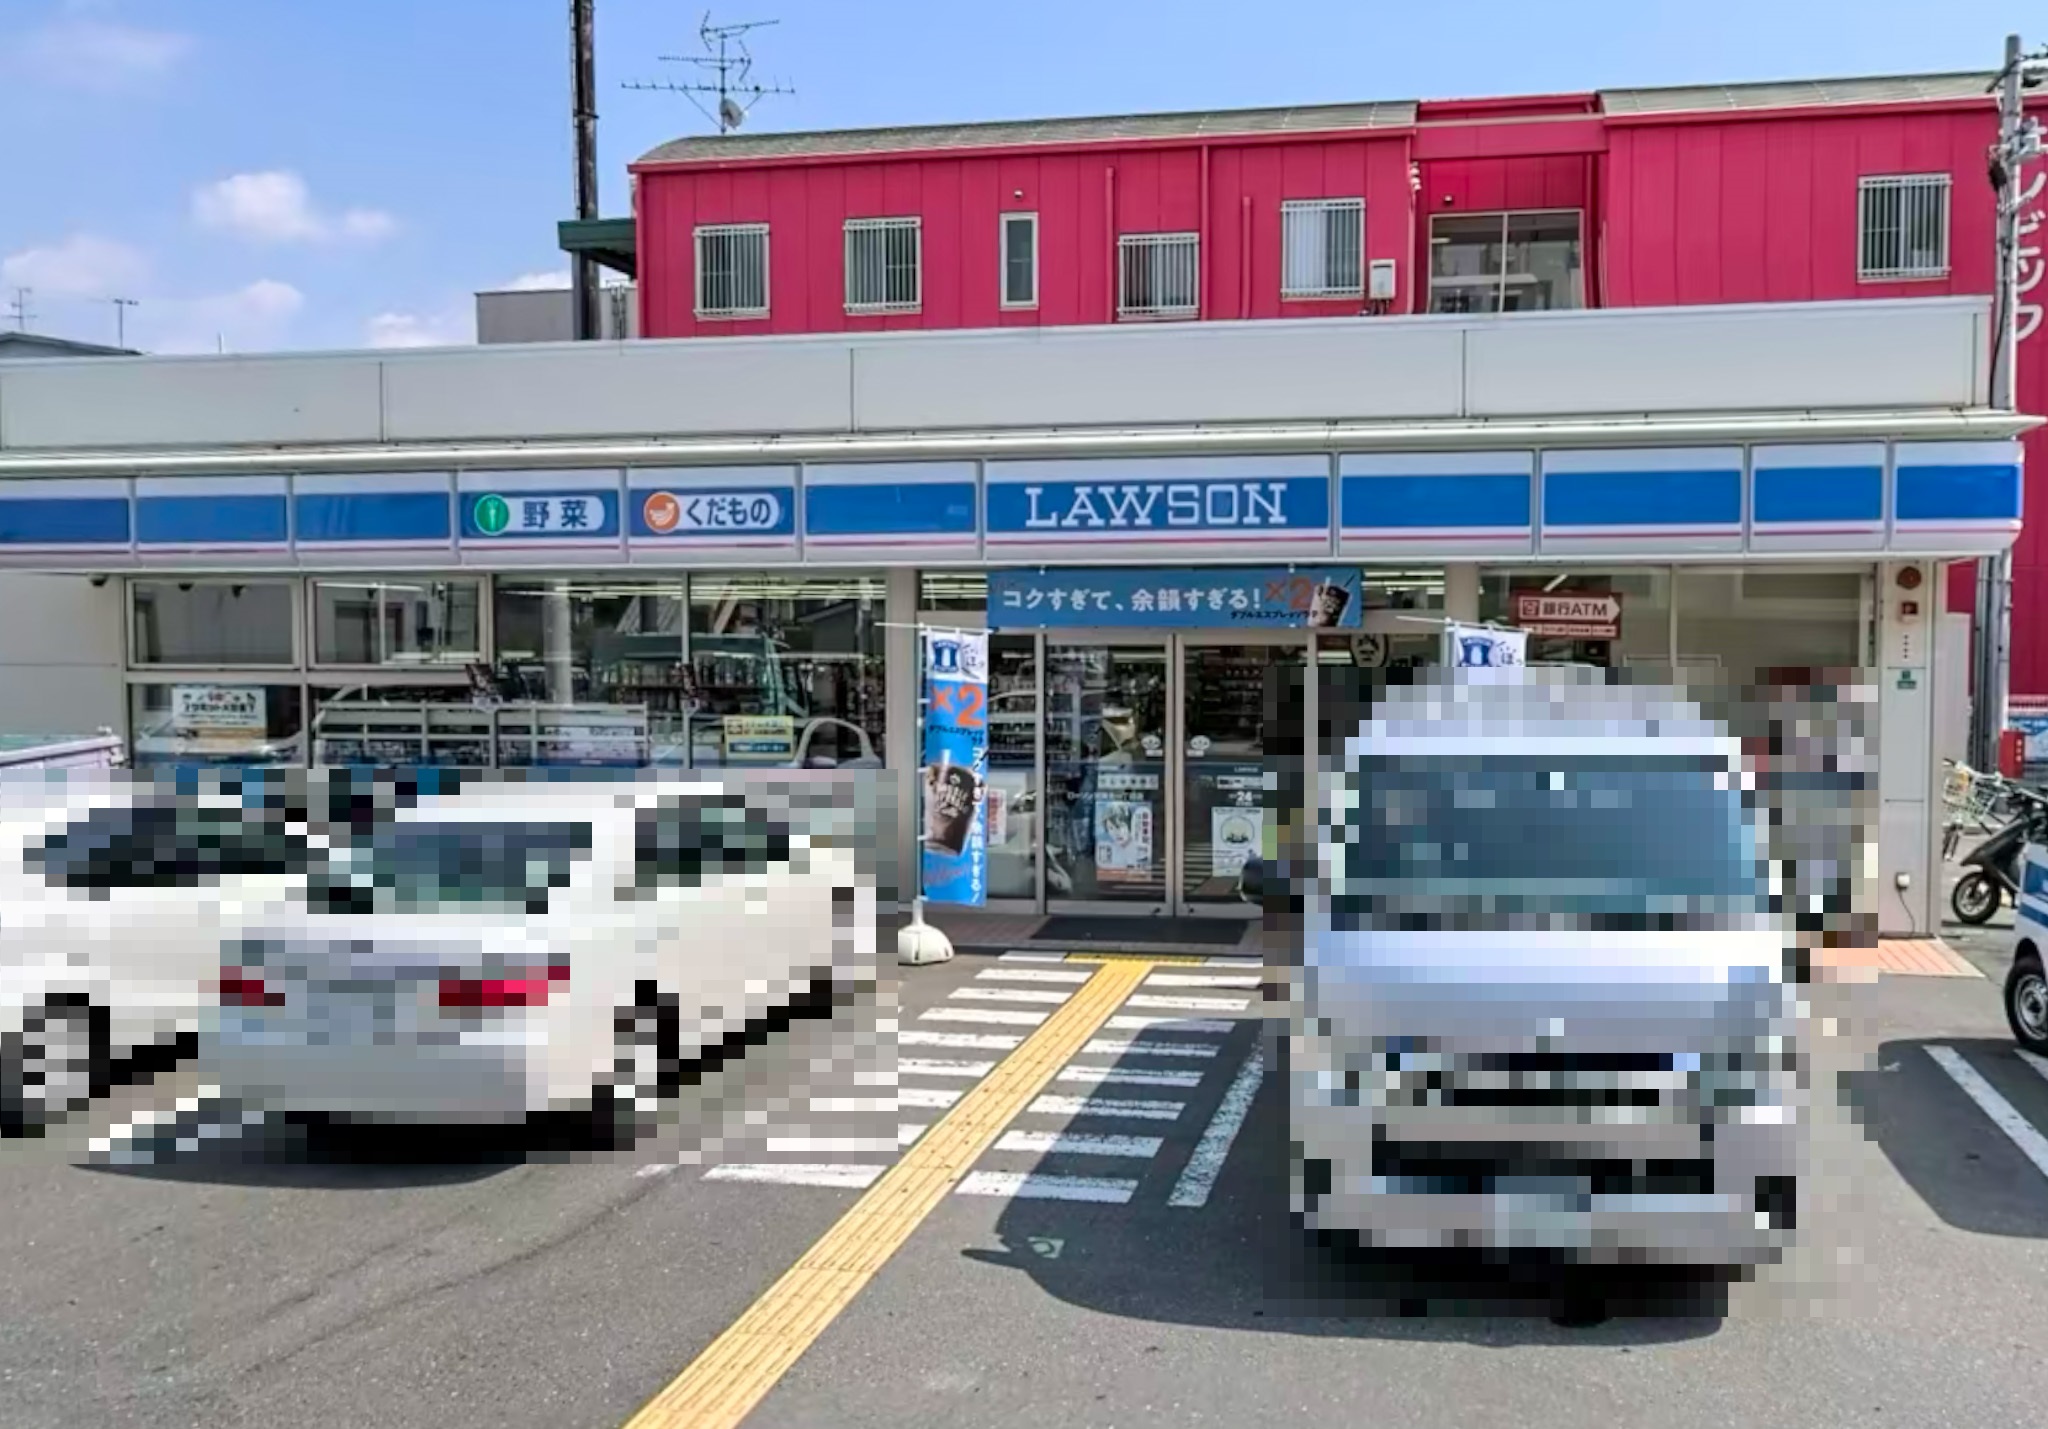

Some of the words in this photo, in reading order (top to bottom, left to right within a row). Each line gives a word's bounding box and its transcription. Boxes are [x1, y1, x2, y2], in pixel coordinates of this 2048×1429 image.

[522, 499, 587, 528] 野菜
[686, 498, 771, 526] くだもの
[1025, 483, 1288, 527] LAWSON
[1543, 601, 1608, 617] 銀行ATM
